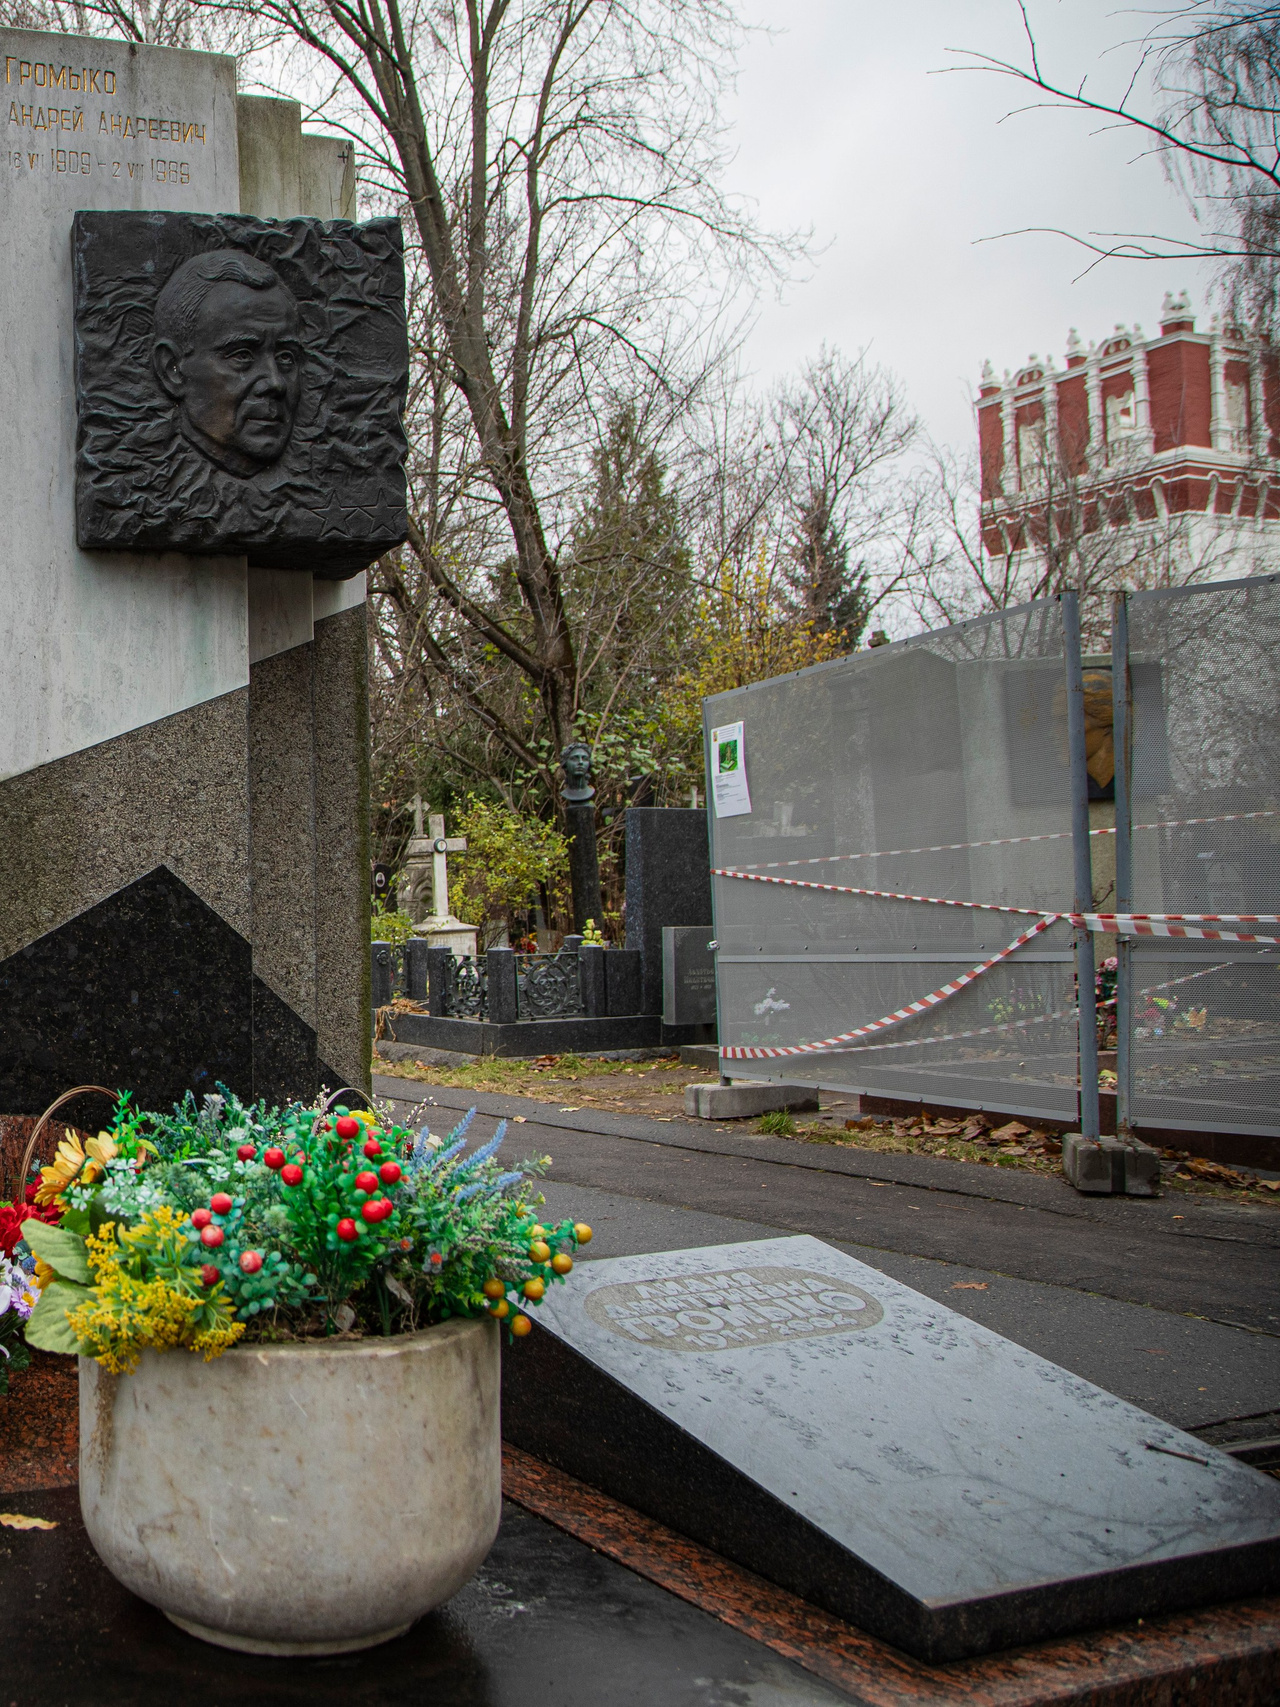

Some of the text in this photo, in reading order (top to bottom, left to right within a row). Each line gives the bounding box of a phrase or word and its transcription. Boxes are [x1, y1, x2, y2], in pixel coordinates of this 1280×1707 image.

[5, 56, 117, 95] ГРОМЫКО
[8, 102, 206, 145] АНДРЕЙ АНДРЕЕВИЧ
[51, 148, 91, 175] 1909
[112, 161, 121, 178] 2
[151, 158, 190, 185] 1989
[604, 1278, 838, 1319] ДМИТРИЕВНА
[634, 1272, 763, 1300] ЛИДИЯ
[615, 1291, 867, 1341] ГРОМЫКО
